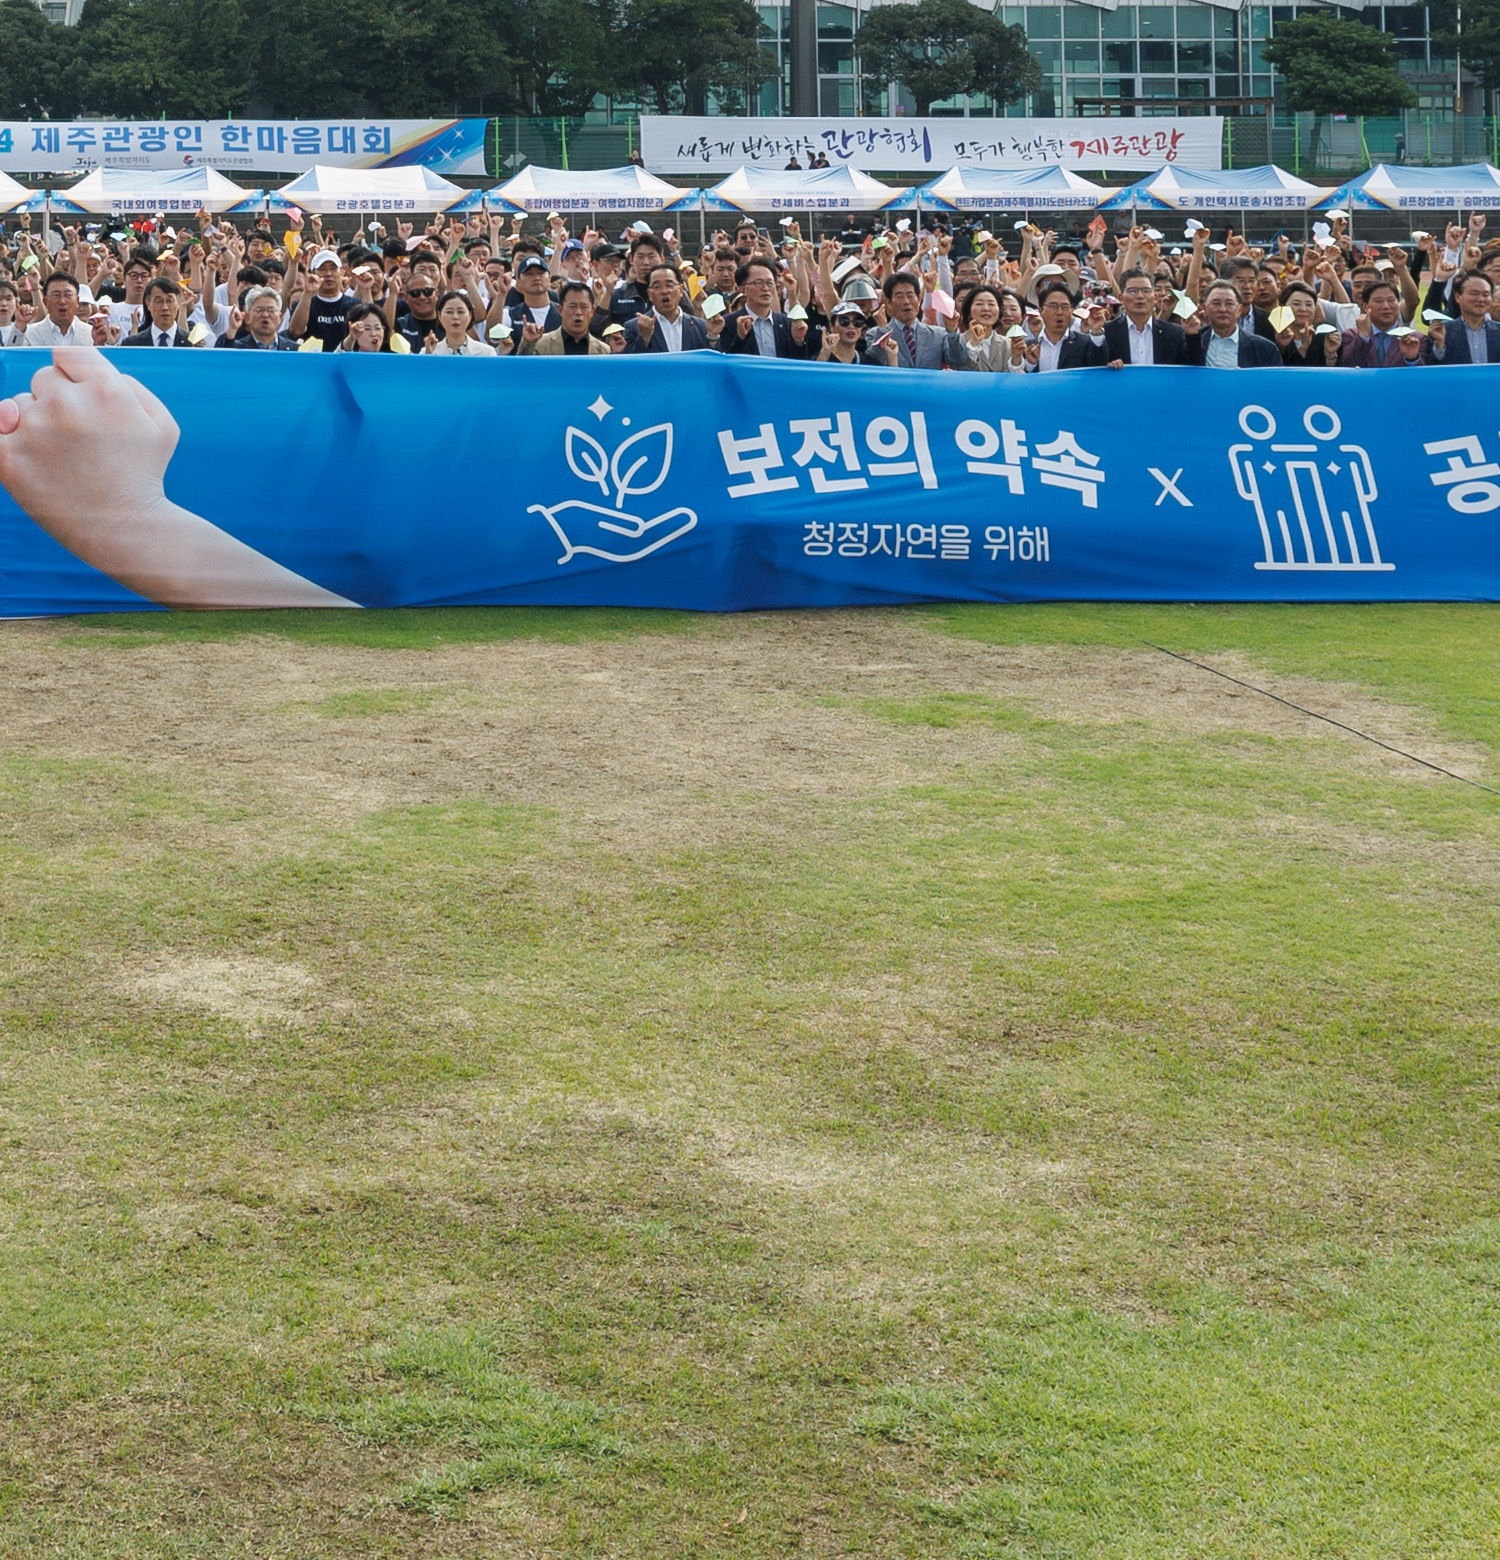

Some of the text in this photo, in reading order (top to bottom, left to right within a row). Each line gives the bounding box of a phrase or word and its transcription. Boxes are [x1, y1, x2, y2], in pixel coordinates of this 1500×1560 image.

[31, 126, 203, 154] 제주관광인
[219, 125, 392, 155] 한마음대회
[677, 126, 1185, 163] 새롭게 변화하는 관광협회 모두가 행복한 제주관광
[105, 155, 152, 164] 제주특별자치도
[111, 199, 203, 210] 국내외여행업분과
[336, 198, 415, 210] 관광호텔업분과
[524, 197, 590, 209] 종합여행업분과
[771, 197, 850, 208] 전세버스업분과
[1178, 195, 1307, 207] 도 개인택시운송사업조합
[1398, 195, 1455, 207] 골프장업분과
[317, 315, 345, 324] DREAM
[718, 412, 1104, 508] 보전의 약속
[804, 522, 1048, 561] 청정자연을 위해
